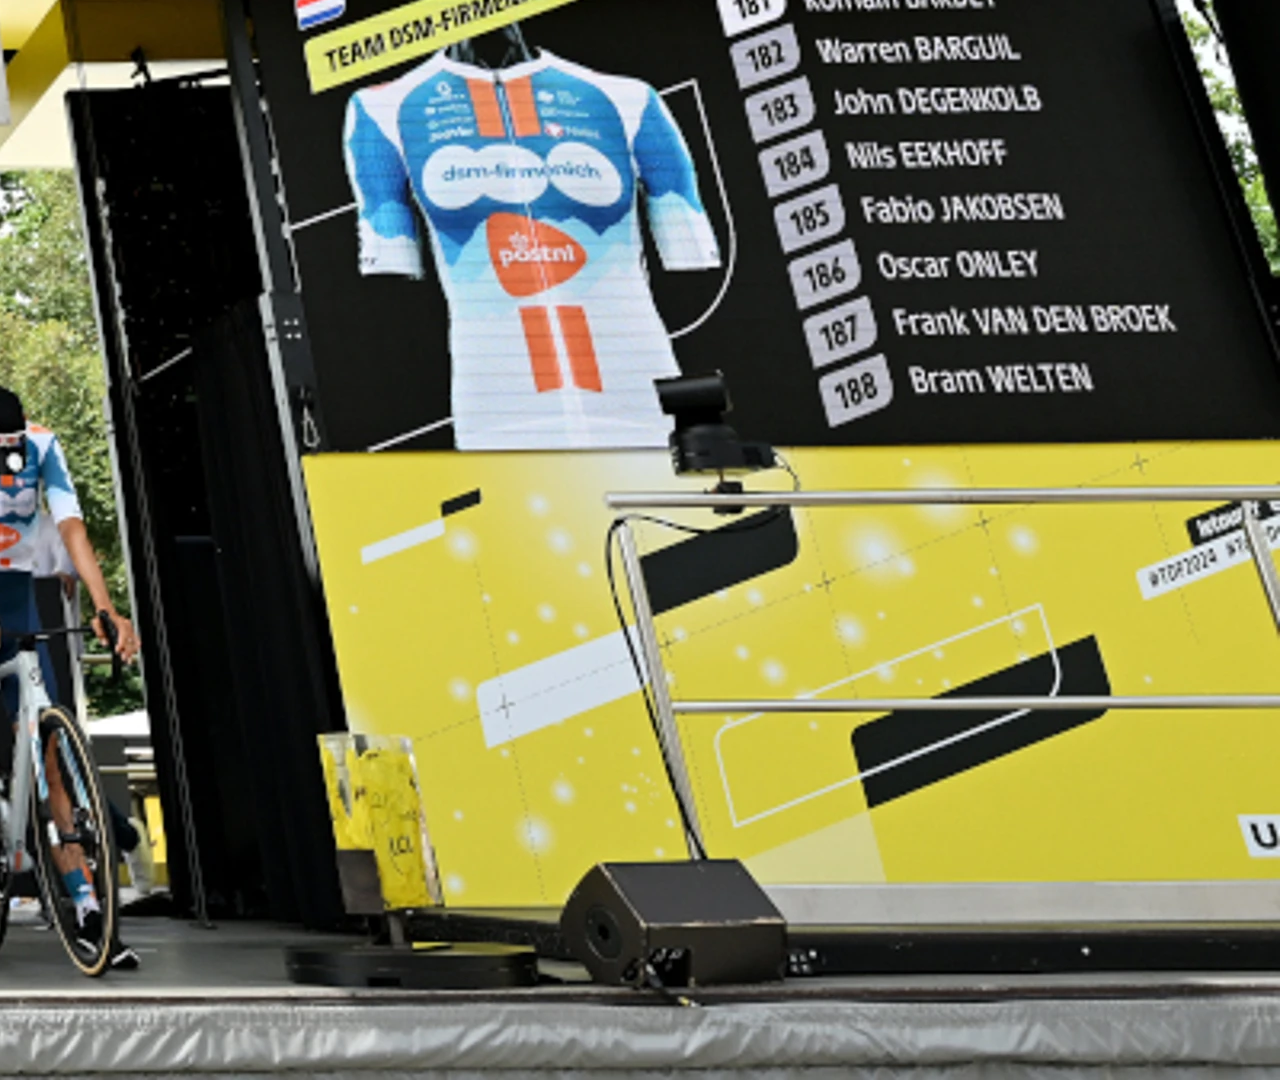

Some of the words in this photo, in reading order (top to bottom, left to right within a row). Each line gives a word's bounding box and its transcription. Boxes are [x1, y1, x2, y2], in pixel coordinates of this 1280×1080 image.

[325, 34, 387, 73] TEAM
[746, 41, 786, 72] 182
[816, 38, 911, 63] Warren
[915, 35, 1022, 61] BARGUIL
[761, 98, 800, 127] 183
[834, 89, 897, 115] John
[898, 85, 1042, 113] DEGENKOLB
[774, 150, 817, 182] 184
[845, 142, 897, 170] Nils
[900, 139, 1008, 168] EEKHOFF
[789, 206, 831, 236] 185
[861, 196, 935, 223] Fabio
[940, 193, 1065, 221] JAKOBSEN
[498, 244, 576, 268] postnl
[803, 260, 847, 292] 186
[877, 251, 952, 279] Oscar
[956, 249, 1039, 277] ONLEY
[819, 315, 859, 350] 187
[892, 308, 971, 335] Frank
[973, 307, 1028, 334] VAN
[1034, 305, 1087, 332] DEN
[1093, 304, 1178, 332] BROEK
[834, 373, 878, 408] 188
[908, 366, 986, 394] Bram
[986, 363, 1095, 391] WELTEN
